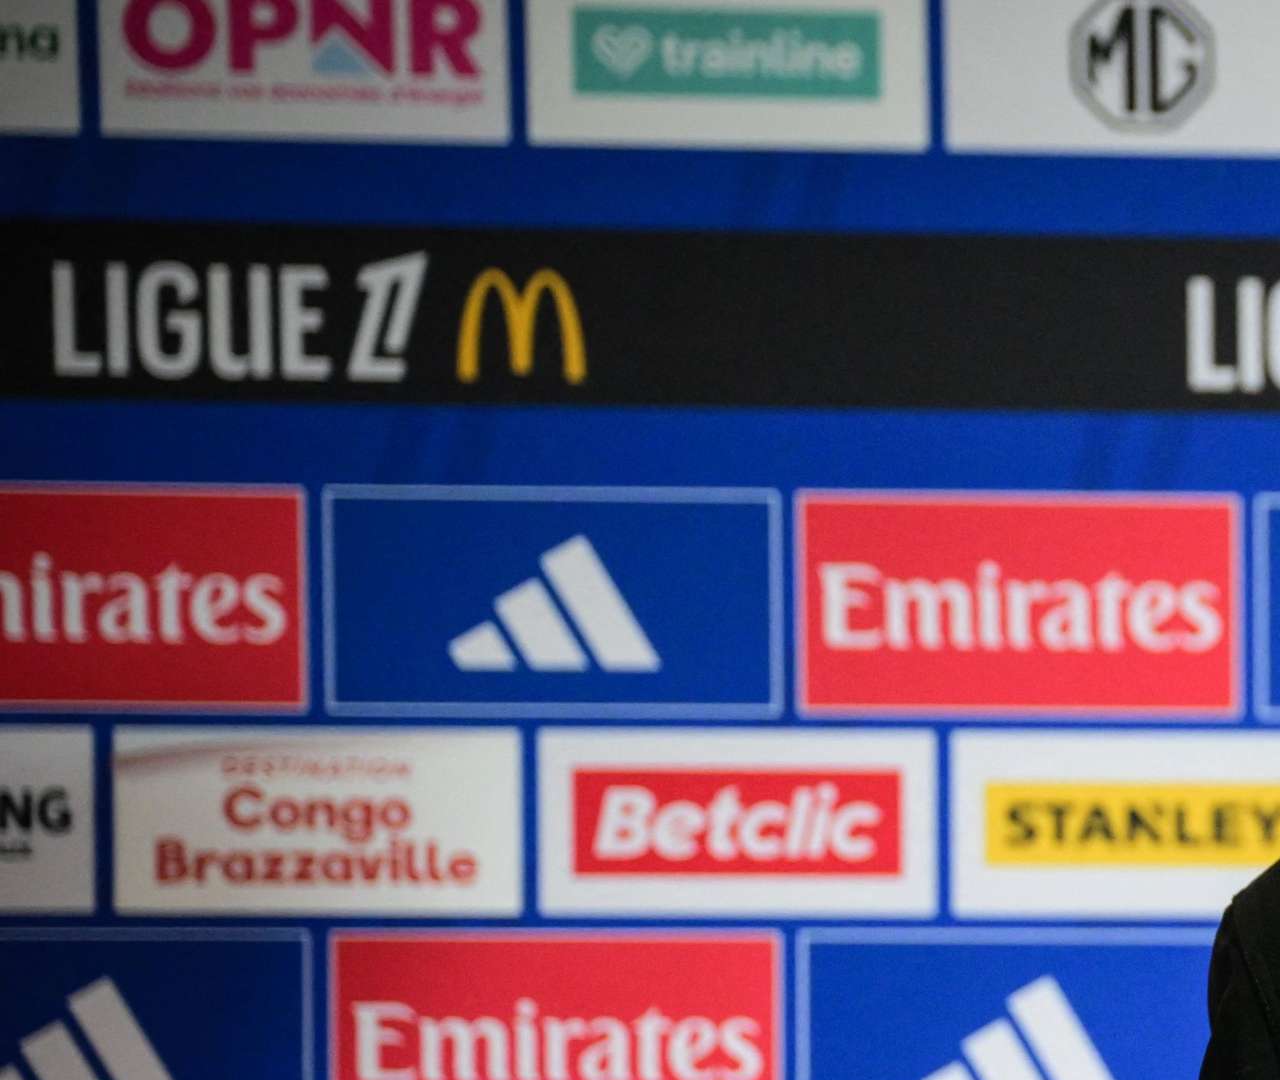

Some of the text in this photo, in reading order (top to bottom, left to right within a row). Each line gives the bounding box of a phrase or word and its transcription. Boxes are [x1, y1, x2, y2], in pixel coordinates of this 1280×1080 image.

[660, 28, 864, 79] trainline
[53, 261, 332, 381] LIGUE
[0, 553, 287, 645] irates
[820, 561, 1223, 652] Emirates
[224, 786, 412, 842] Congo
[593, 783, 880, 861] Betclic
[155, 836, 478, 885] Brazzaville
